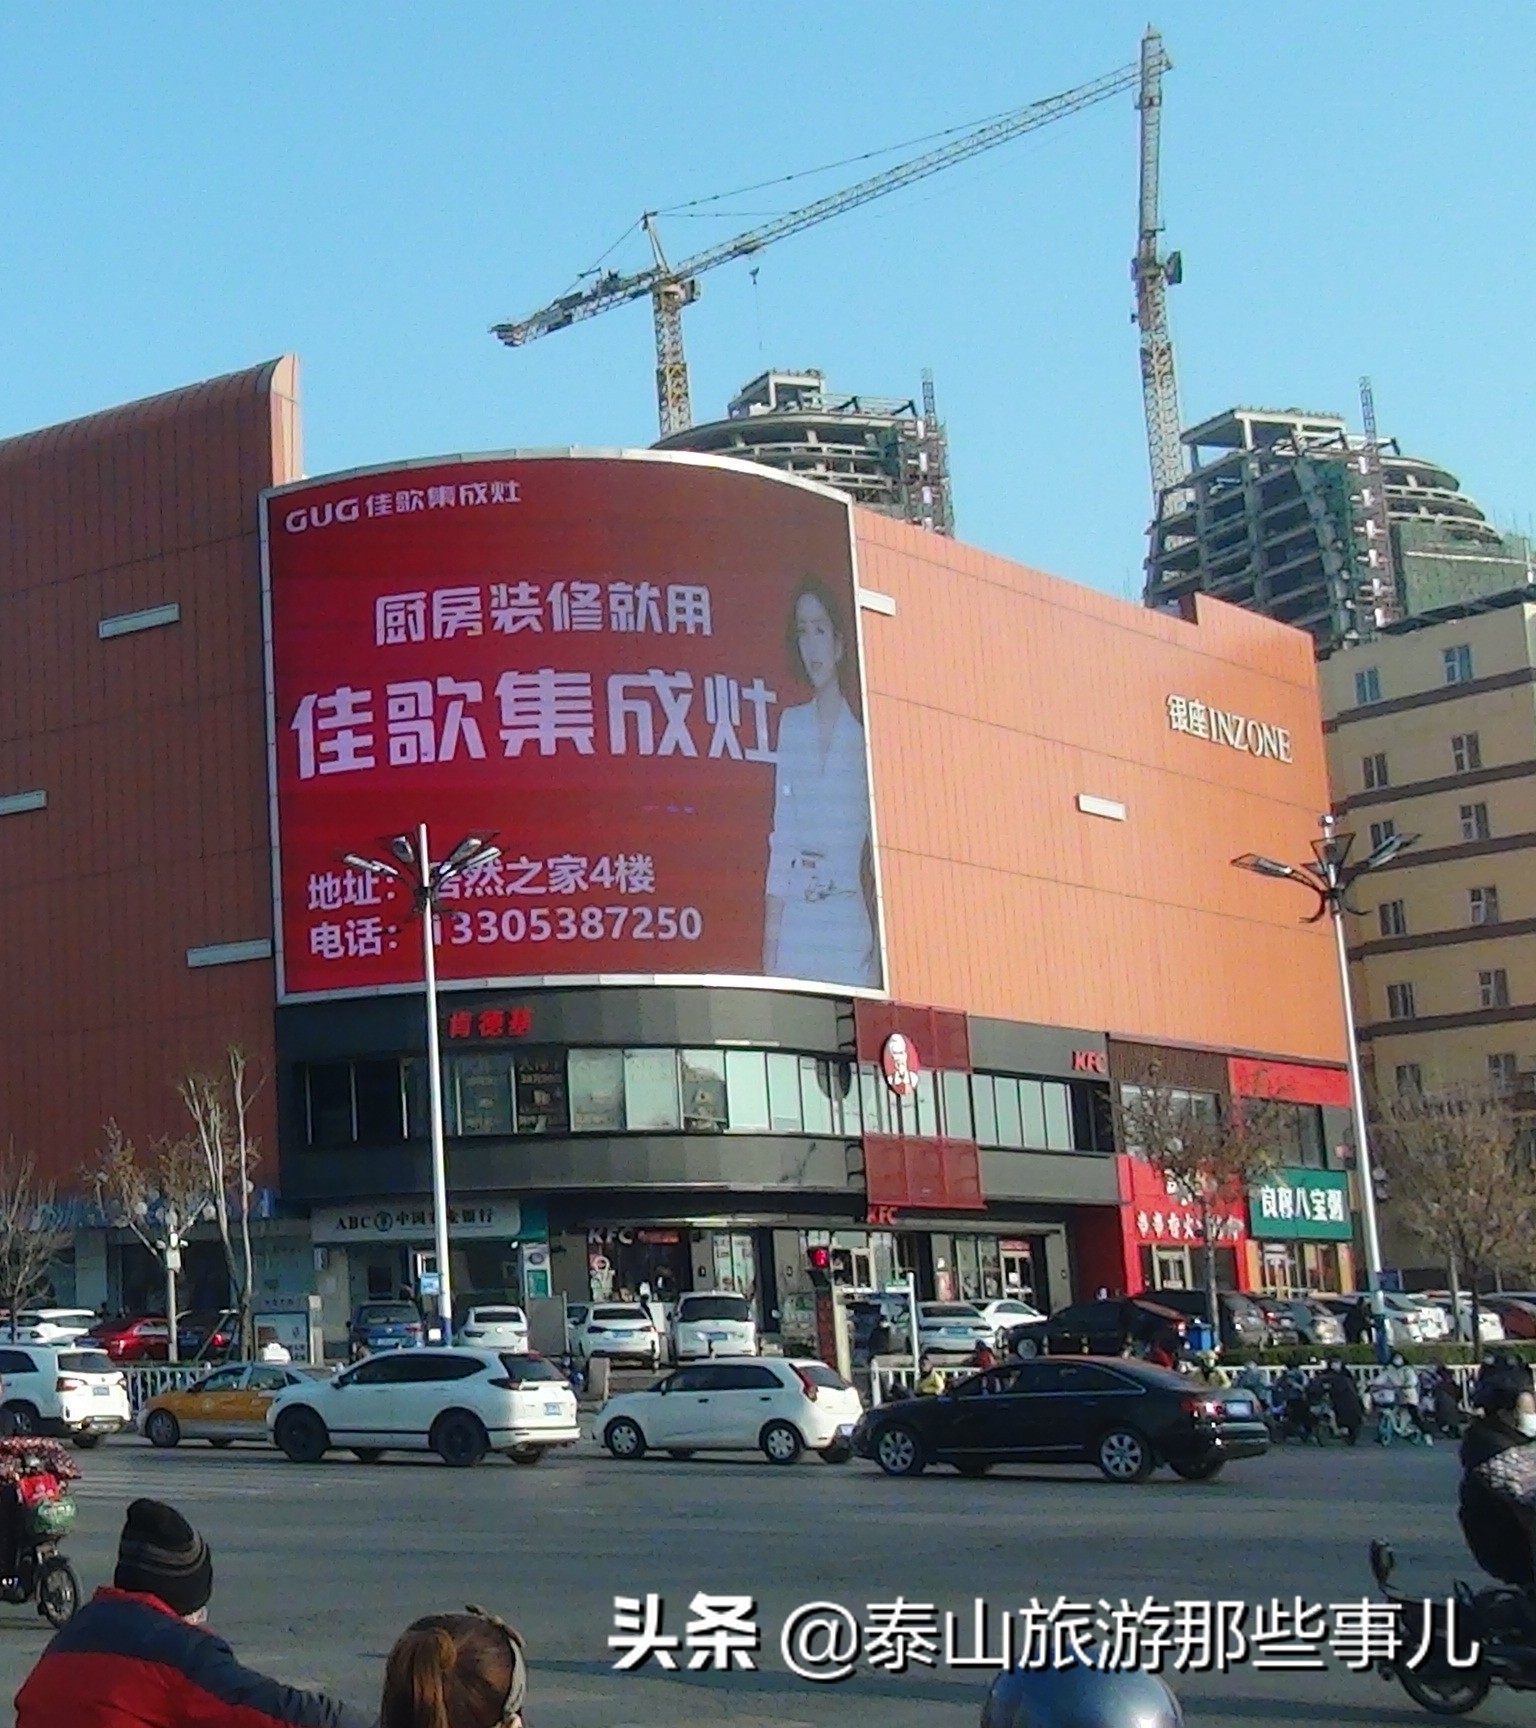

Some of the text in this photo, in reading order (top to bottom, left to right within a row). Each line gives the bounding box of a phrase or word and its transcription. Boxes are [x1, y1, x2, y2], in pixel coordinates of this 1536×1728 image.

[285, 480, 522, 534] GUG 佳歌集成灶
[375, 578, 714, 646] 厨房装修就用
[289, 667, 781, 781] 佳歌集成灶
[448, 1005, 533, 1040] 肯德基
[1071, 1050, 1107, 1074] KFC
[336, 1207, 494, 1230] ABC 中国业银行
[867, 1206, 899, 1225] KFC
[588, 1227, 634, 1245] KFC
